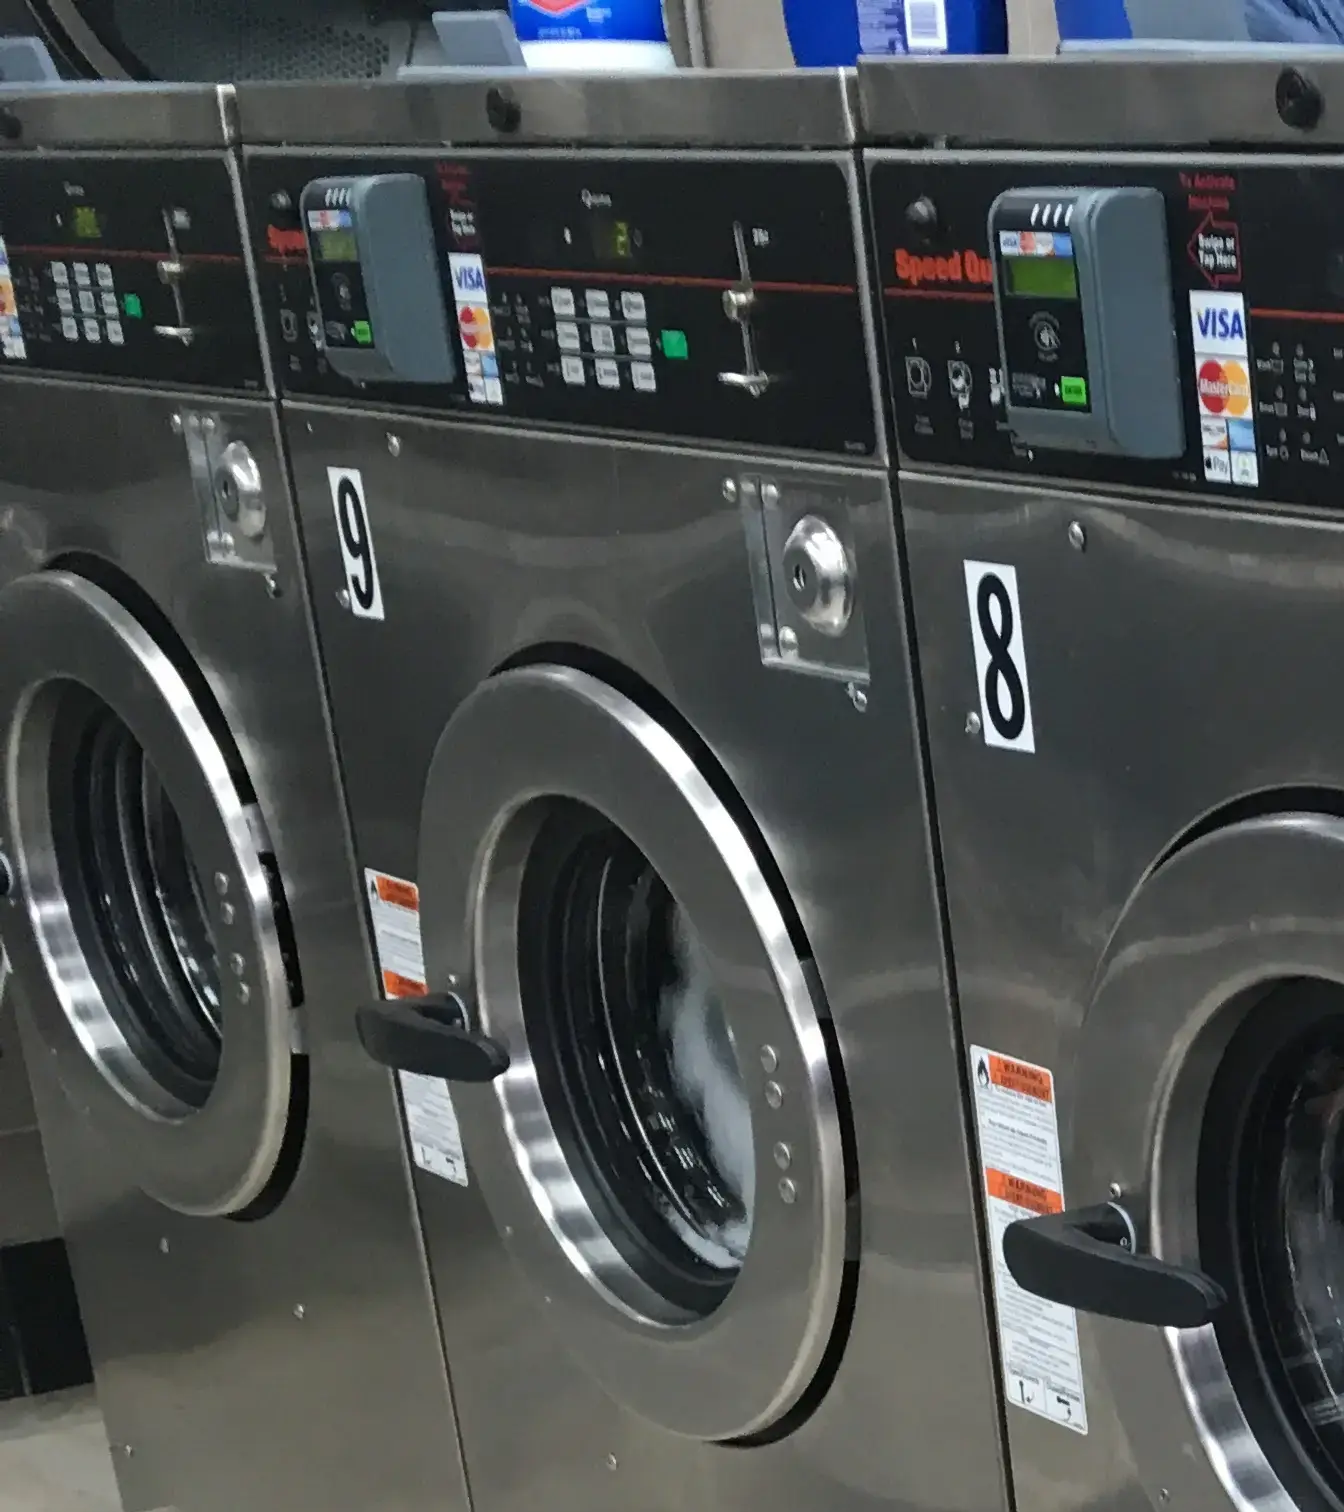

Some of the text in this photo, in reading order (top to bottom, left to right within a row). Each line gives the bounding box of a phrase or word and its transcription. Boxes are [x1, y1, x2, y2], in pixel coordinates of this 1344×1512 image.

[455, 266, 486, 292] VISA
[895, 249, 962, 285] Speed
[1198, 307, 1244, 340] VISA
[338, 476, 374, 610] 9
[977, 572, 1025, 740] 8
